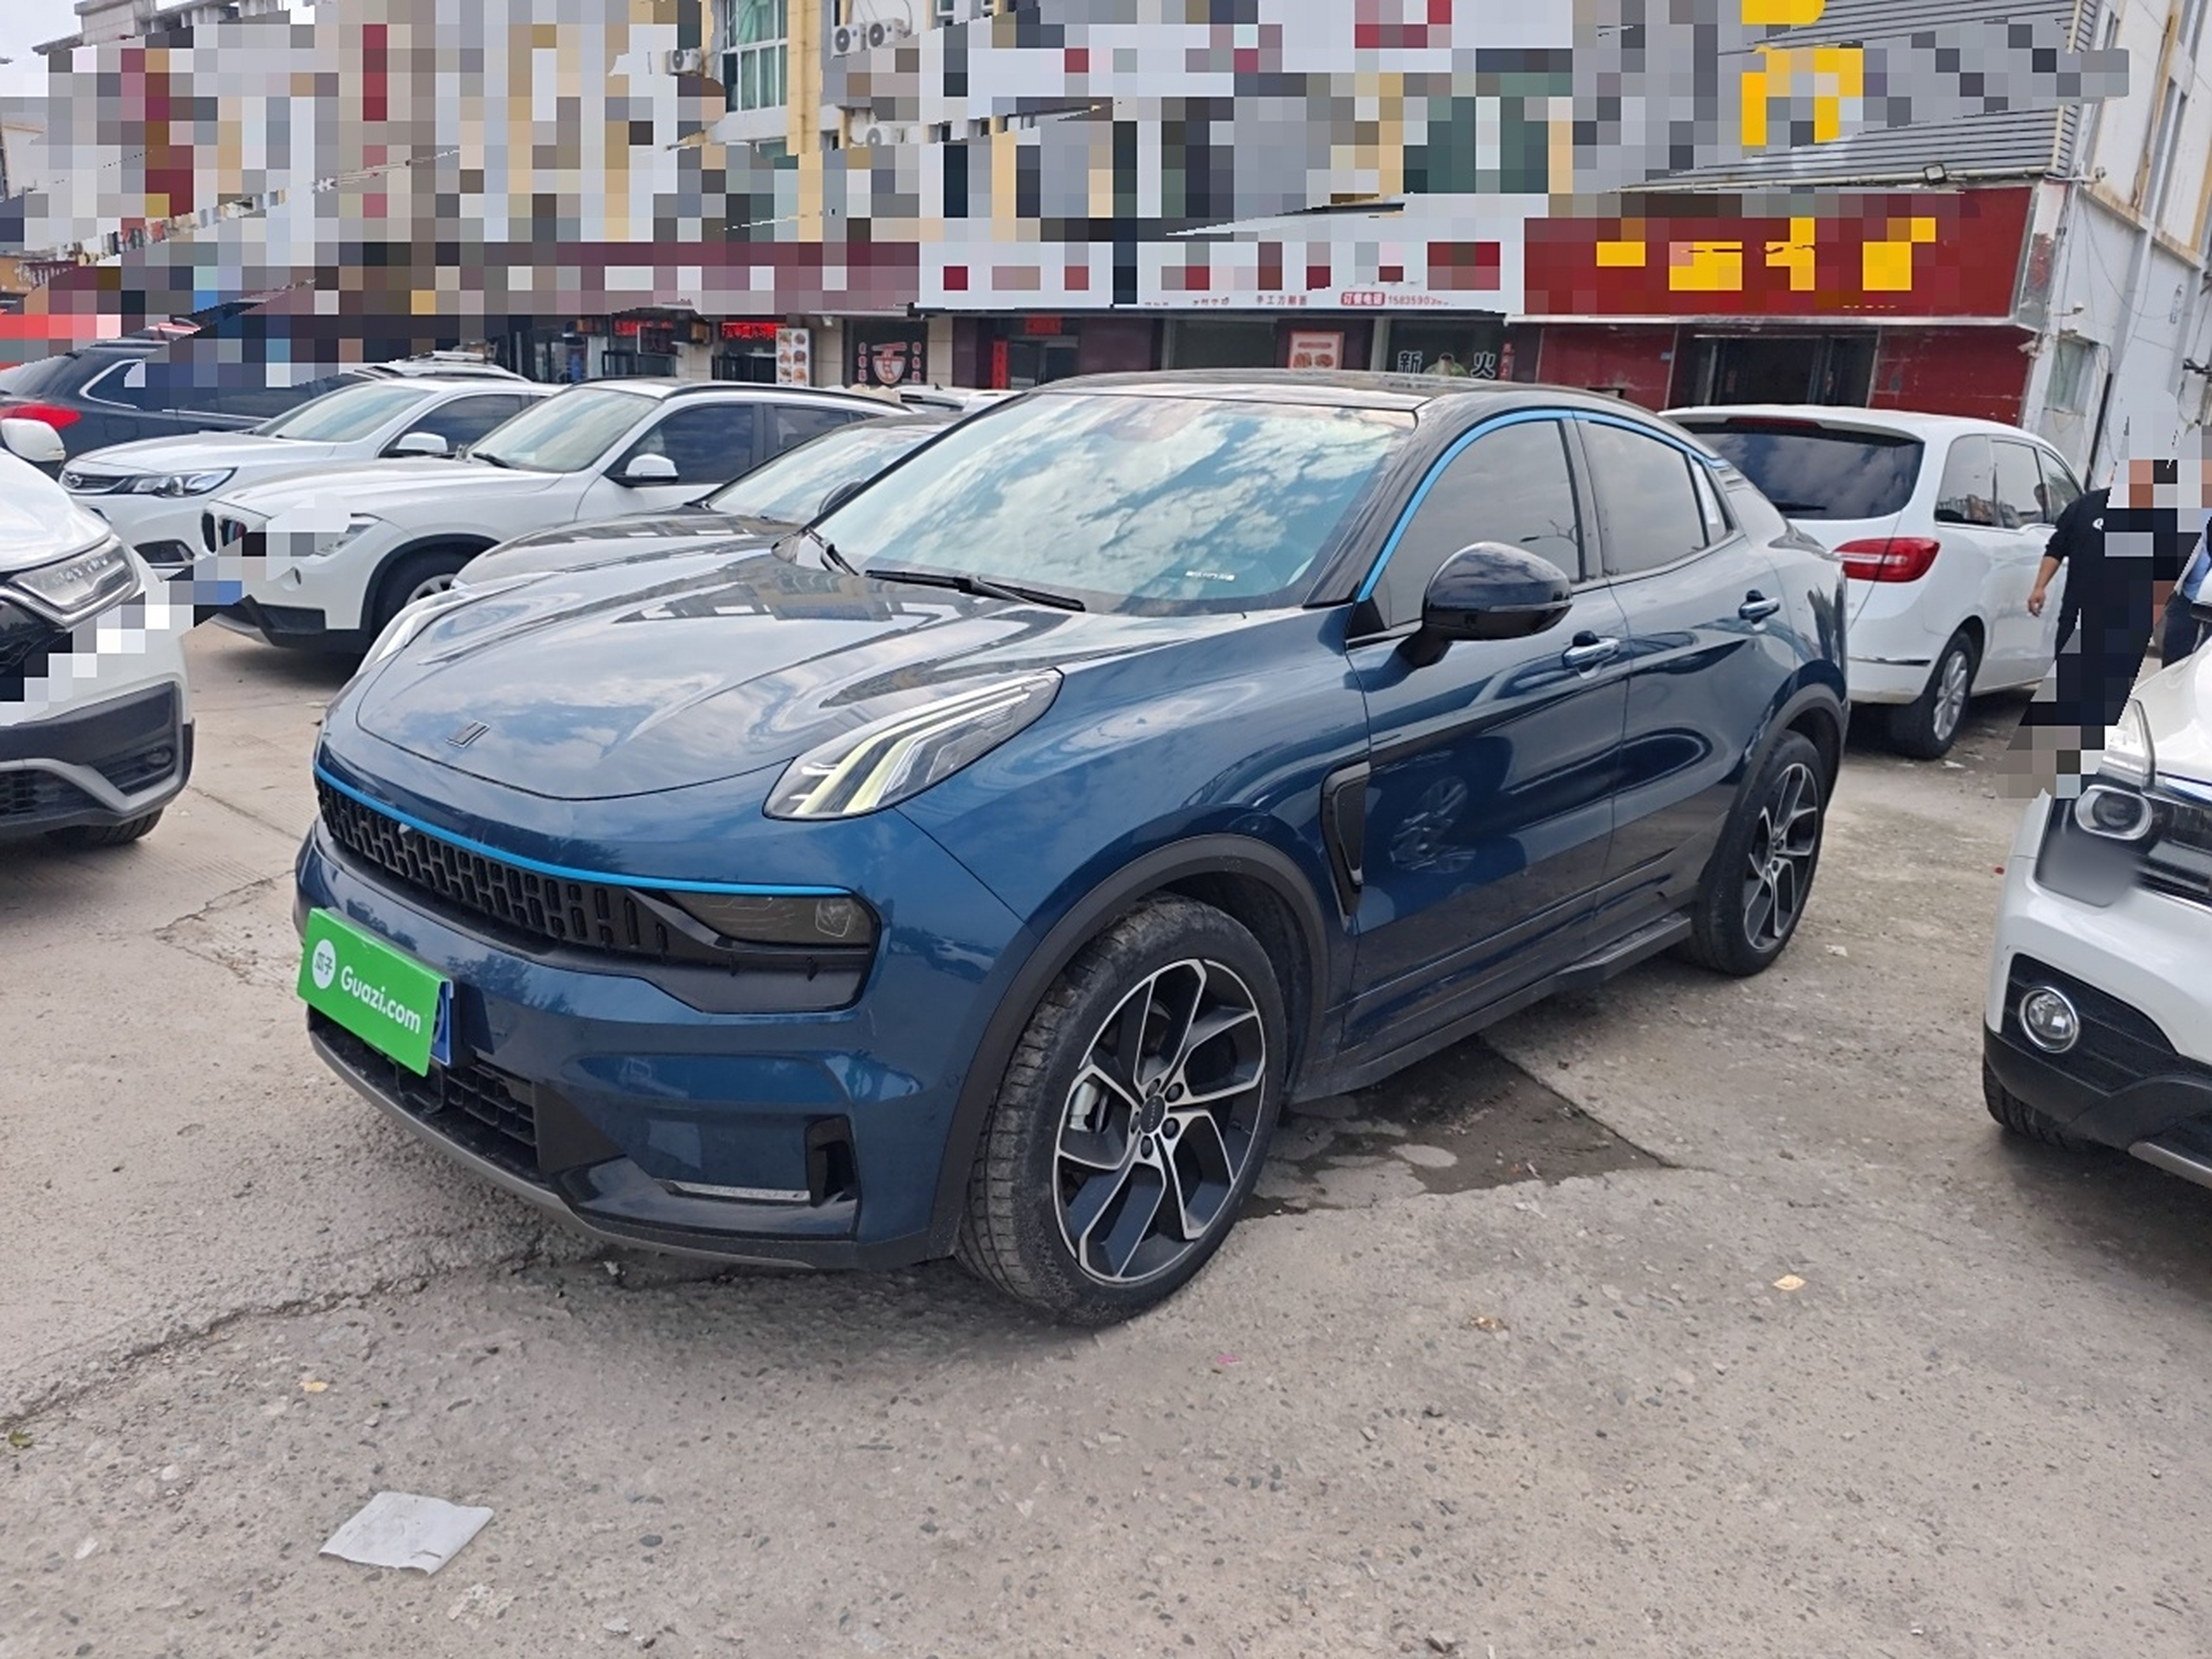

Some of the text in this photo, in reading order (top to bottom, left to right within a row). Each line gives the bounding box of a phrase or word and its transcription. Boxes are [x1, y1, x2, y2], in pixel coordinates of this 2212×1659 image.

[1398, 351, 1423, 374] 新
[1471, 351, 1497, 378] 火
[341, 965, 421, 1034] Guazi.com
